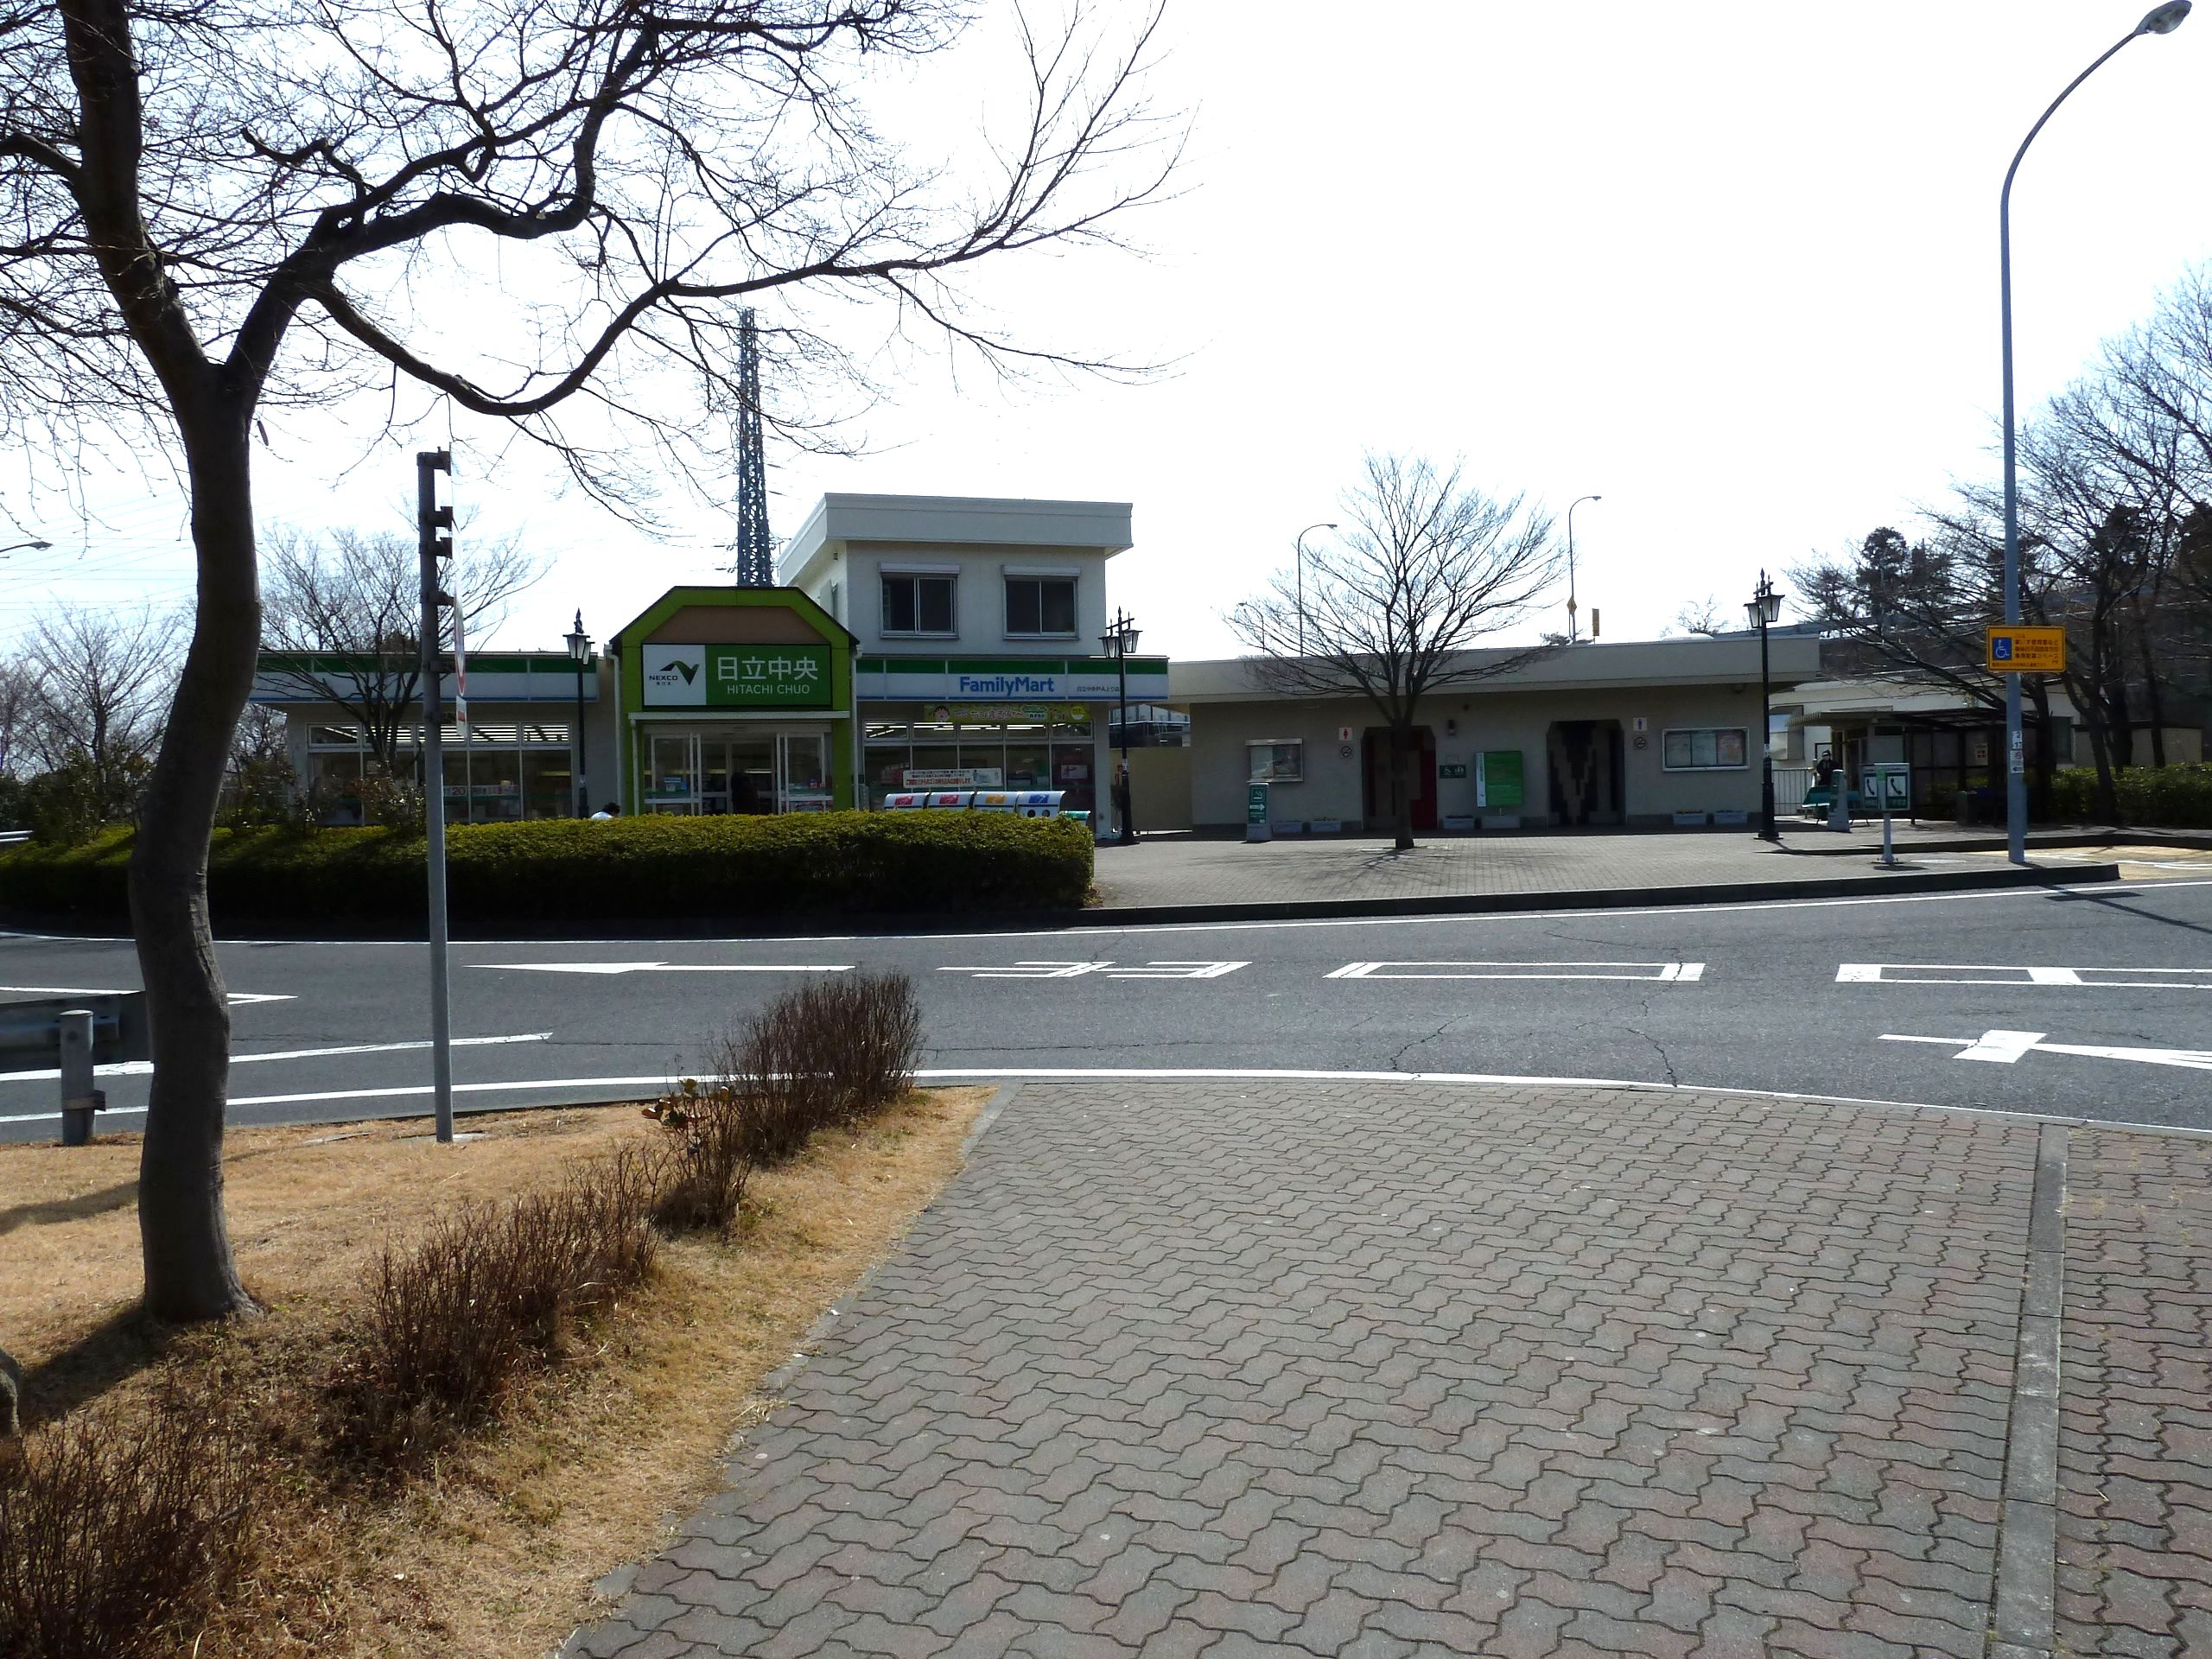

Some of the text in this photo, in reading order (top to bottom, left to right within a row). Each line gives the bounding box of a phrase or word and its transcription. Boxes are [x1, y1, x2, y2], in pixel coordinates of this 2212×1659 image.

[717, 656, 818, 681] 日立中央
[727, 684, 810, 695] HITACHI CHUO
[959, 676, 1054, 696] FamilyMart
